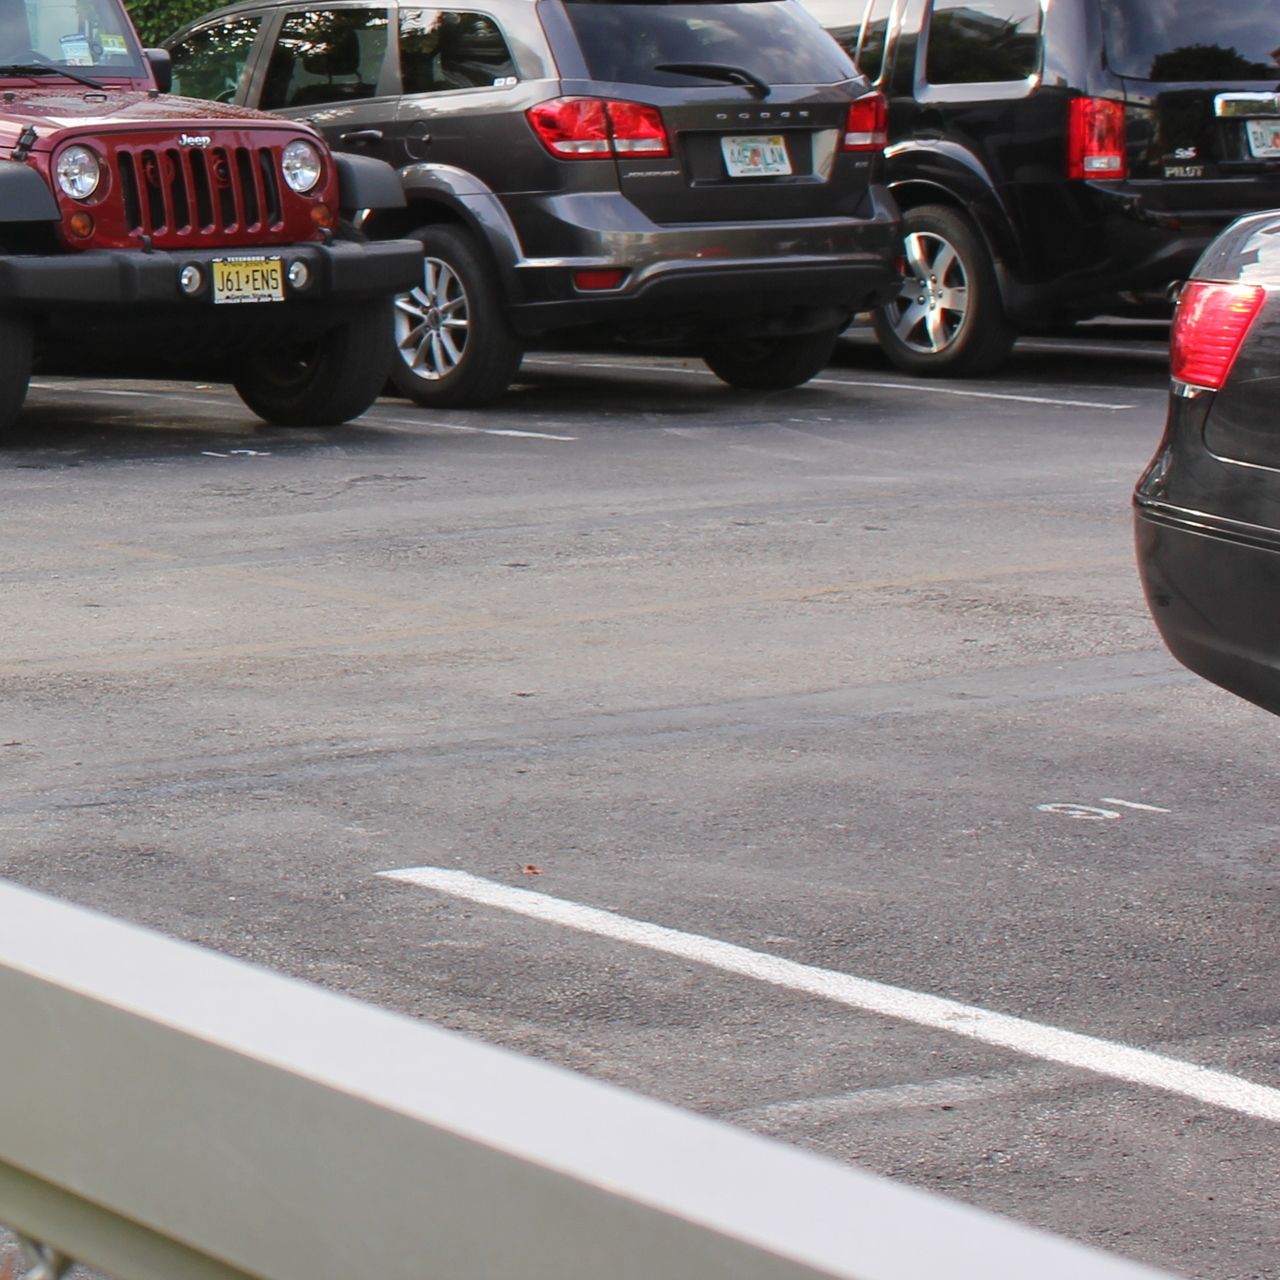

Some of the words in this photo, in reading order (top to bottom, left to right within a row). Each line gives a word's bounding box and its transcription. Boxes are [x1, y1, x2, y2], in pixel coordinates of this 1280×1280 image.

[716, 110, 809, 120] DODGE
[178, 133, 211, 149] Jeep
[1164, 166, 1204, 178] PILOT
[217, 270, 243, 292] J61
[252, 268, 280, 291] ENS
